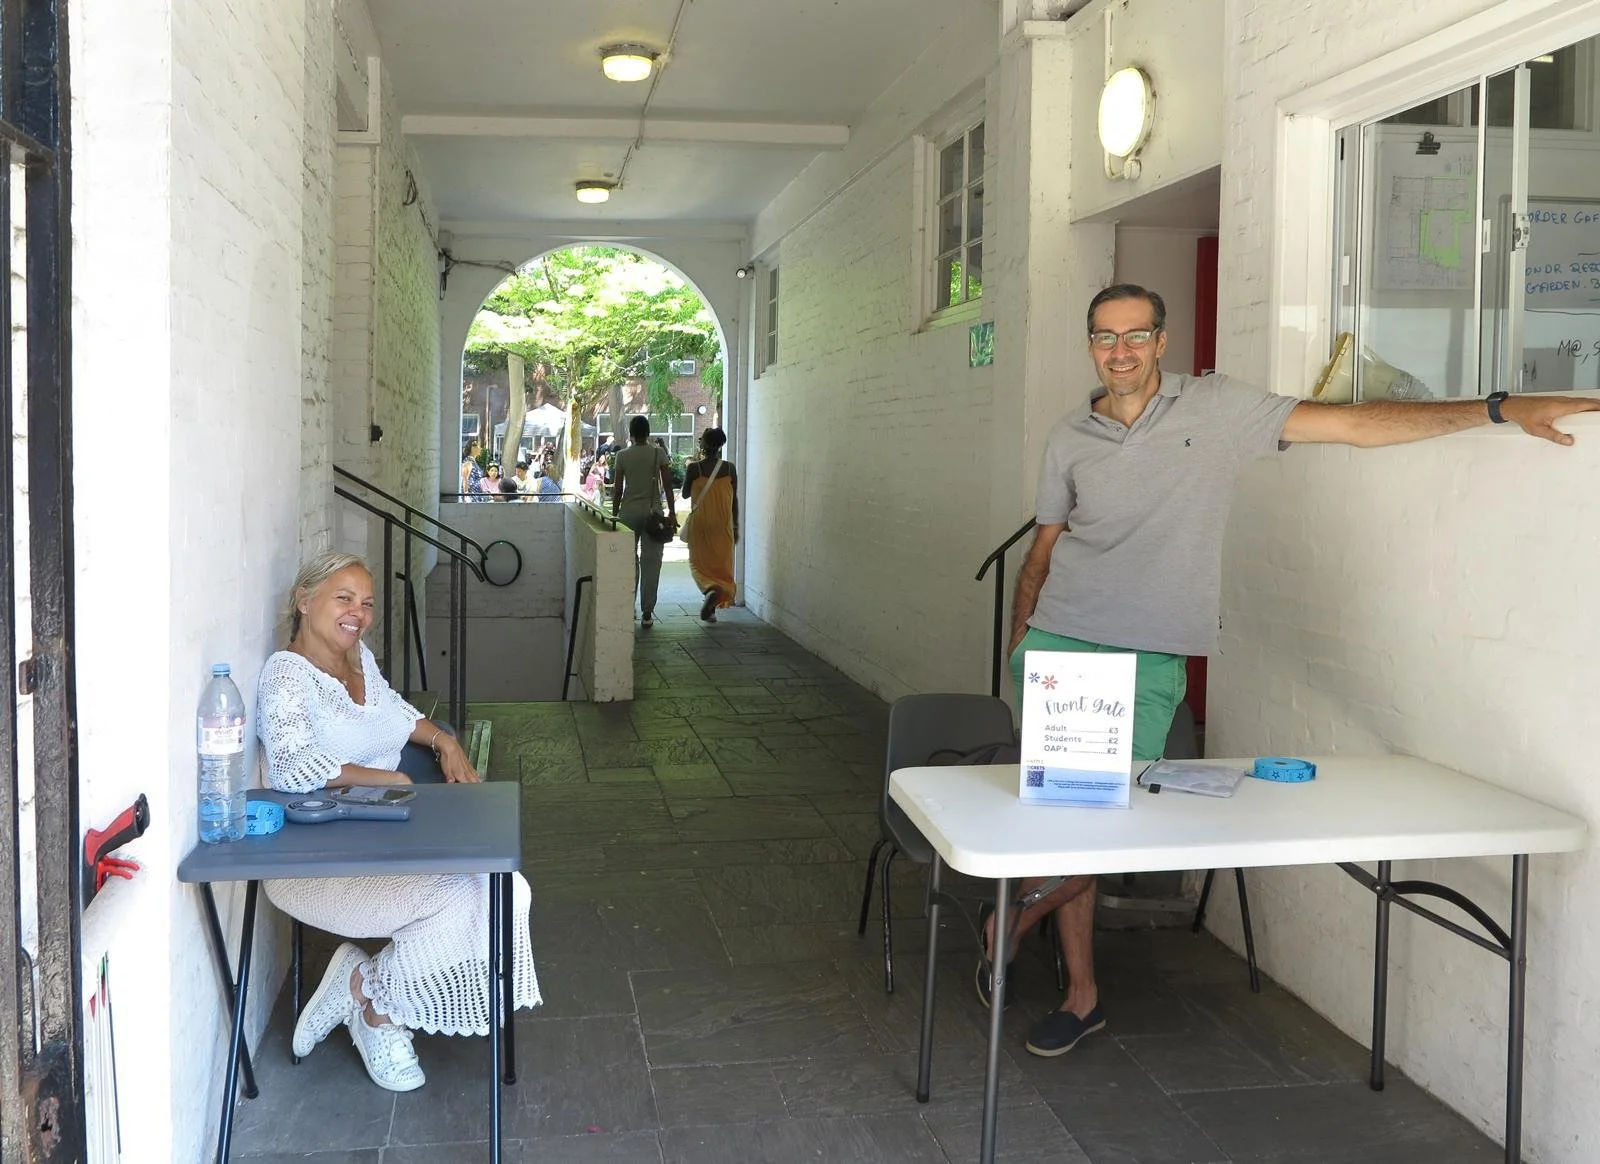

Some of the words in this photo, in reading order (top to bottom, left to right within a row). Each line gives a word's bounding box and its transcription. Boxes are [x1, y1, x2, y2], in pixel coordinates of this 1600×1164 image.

[1045, 695, 1088, 715] Front
[1044, 724, 1067, 732] Adult
[1108, 727, 1119, 735] £3
[1044, 734, 1082, 743] Students
[1108, 737, 1119, 745] £2
[1044, 744, 1068, 752] OAP's
[1107, 747, 1117, 755] £2
